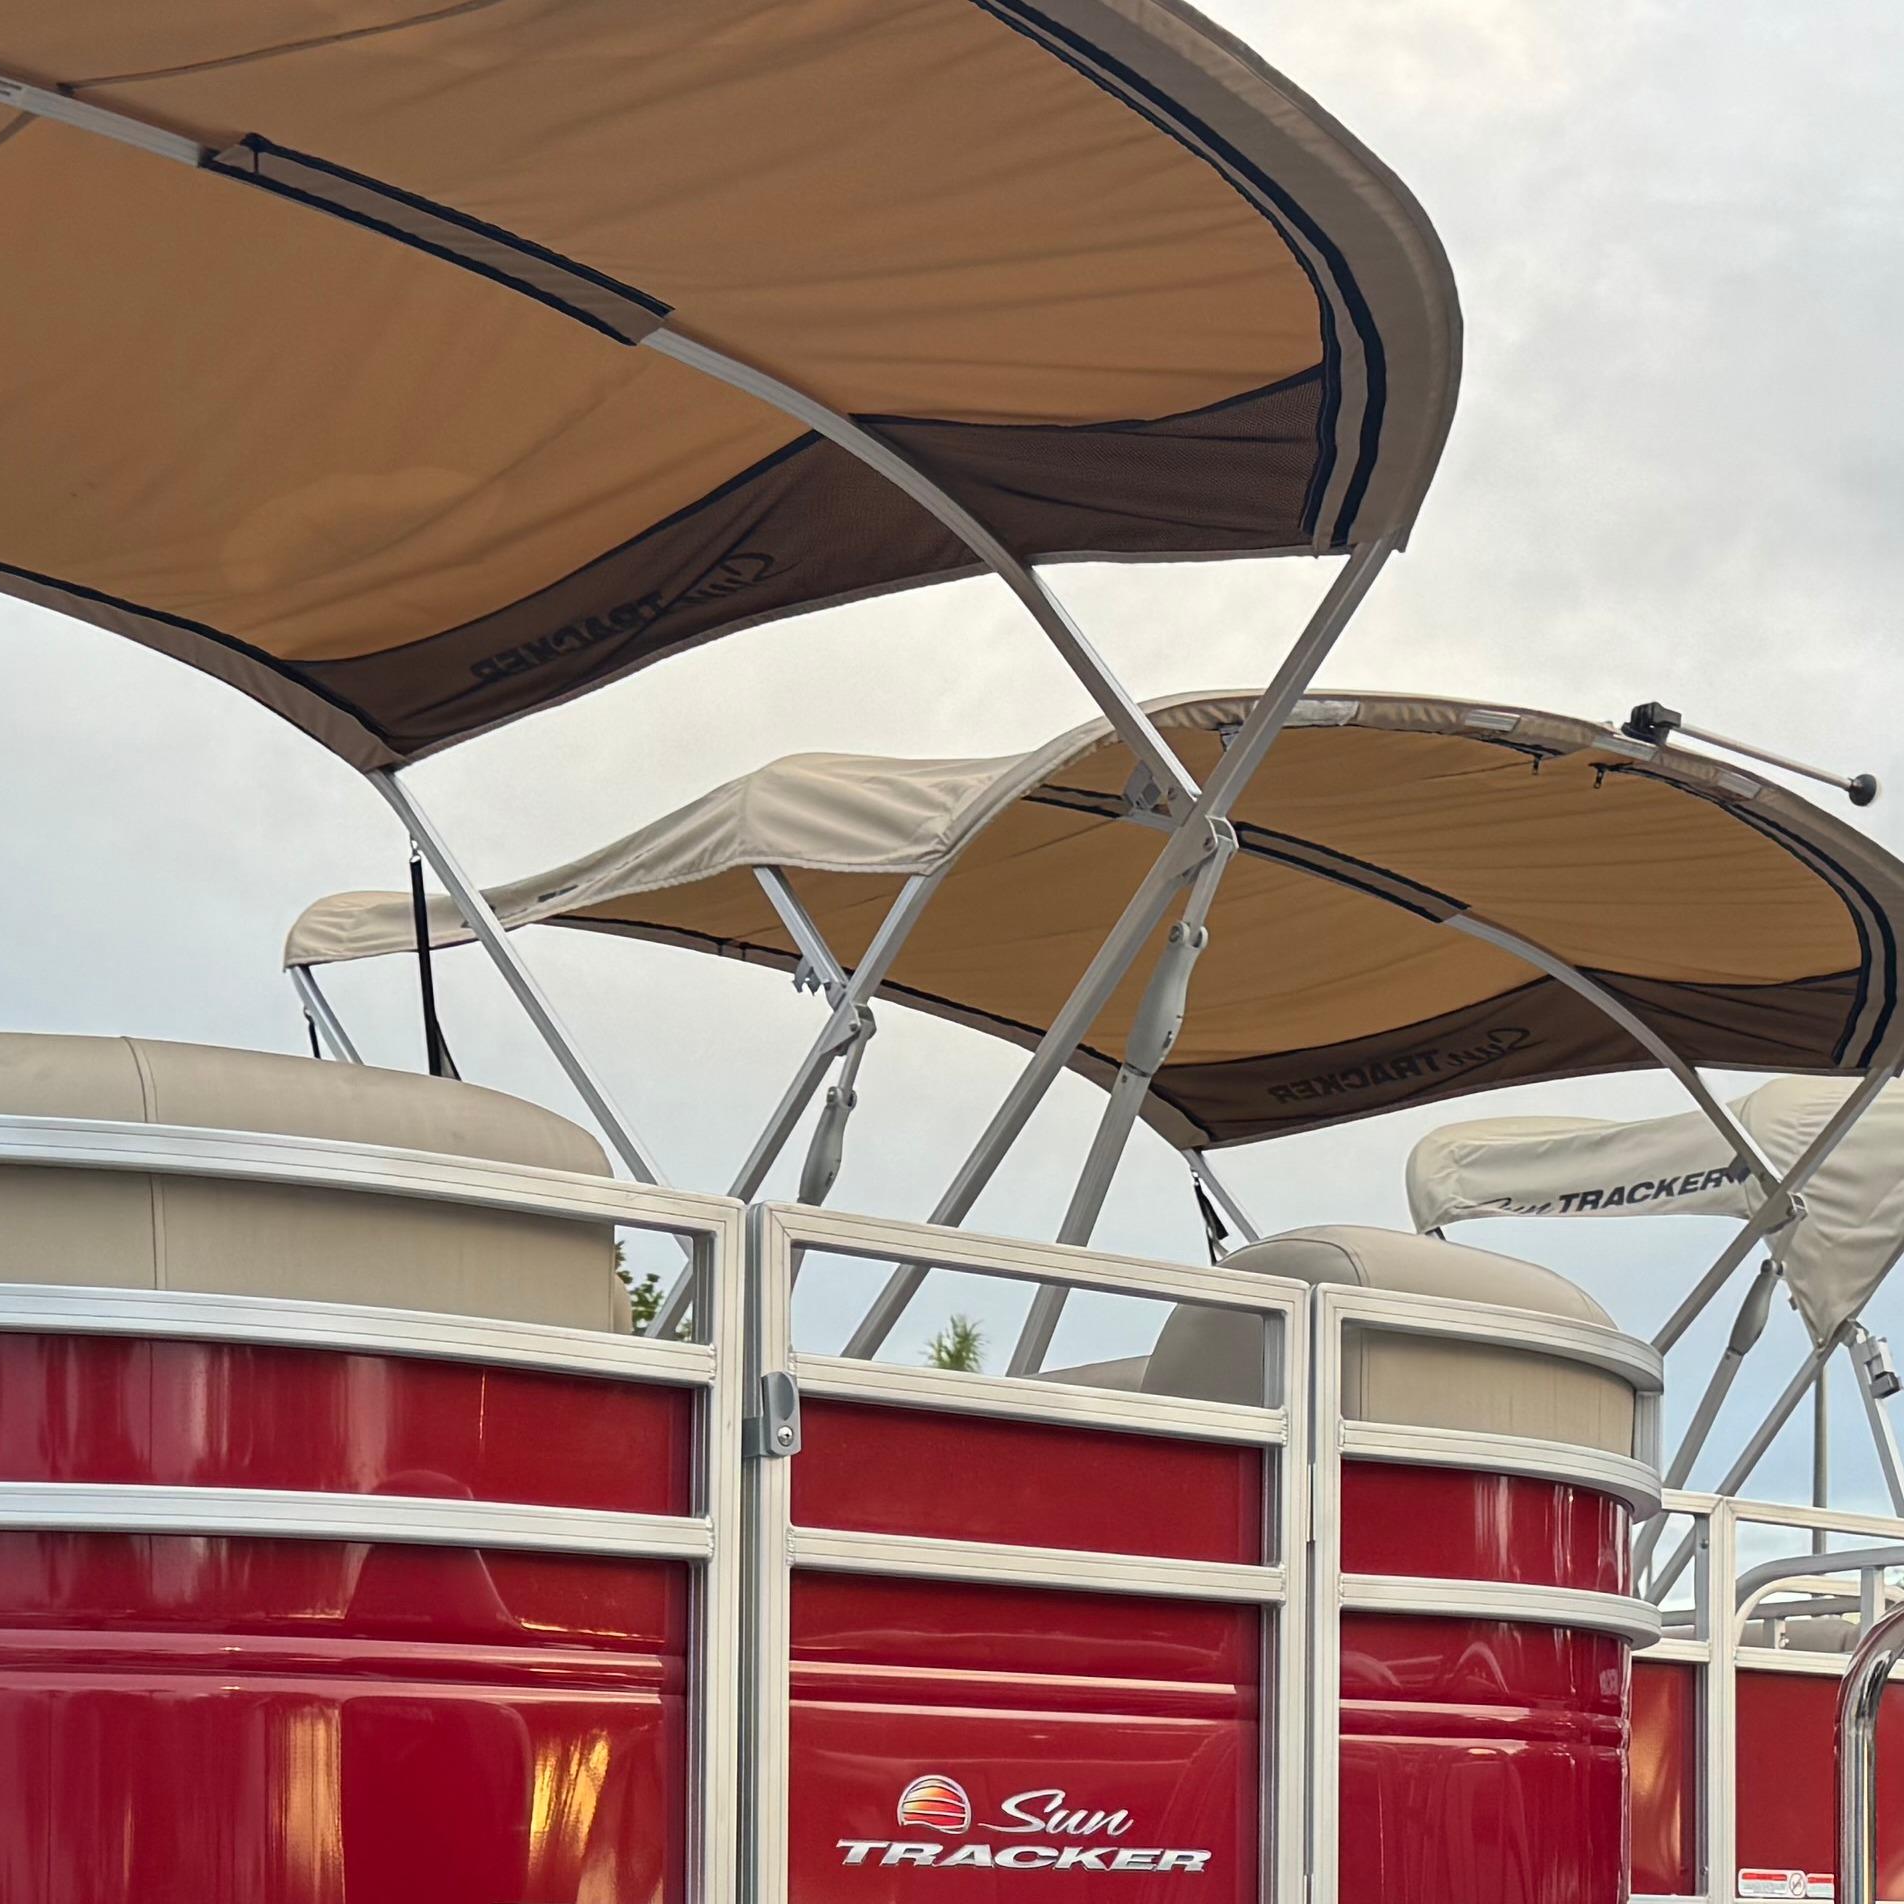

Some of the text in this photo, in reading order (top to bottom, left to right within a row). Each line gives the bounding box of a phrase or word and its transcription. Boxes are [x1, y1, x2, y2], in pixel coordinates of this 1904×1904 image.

[1559, 1167, 1728, 1213] TRACKER
[978, 1788, 1134, 1837] Sun
[836, 1838, 1212, 1873] TRACKER
